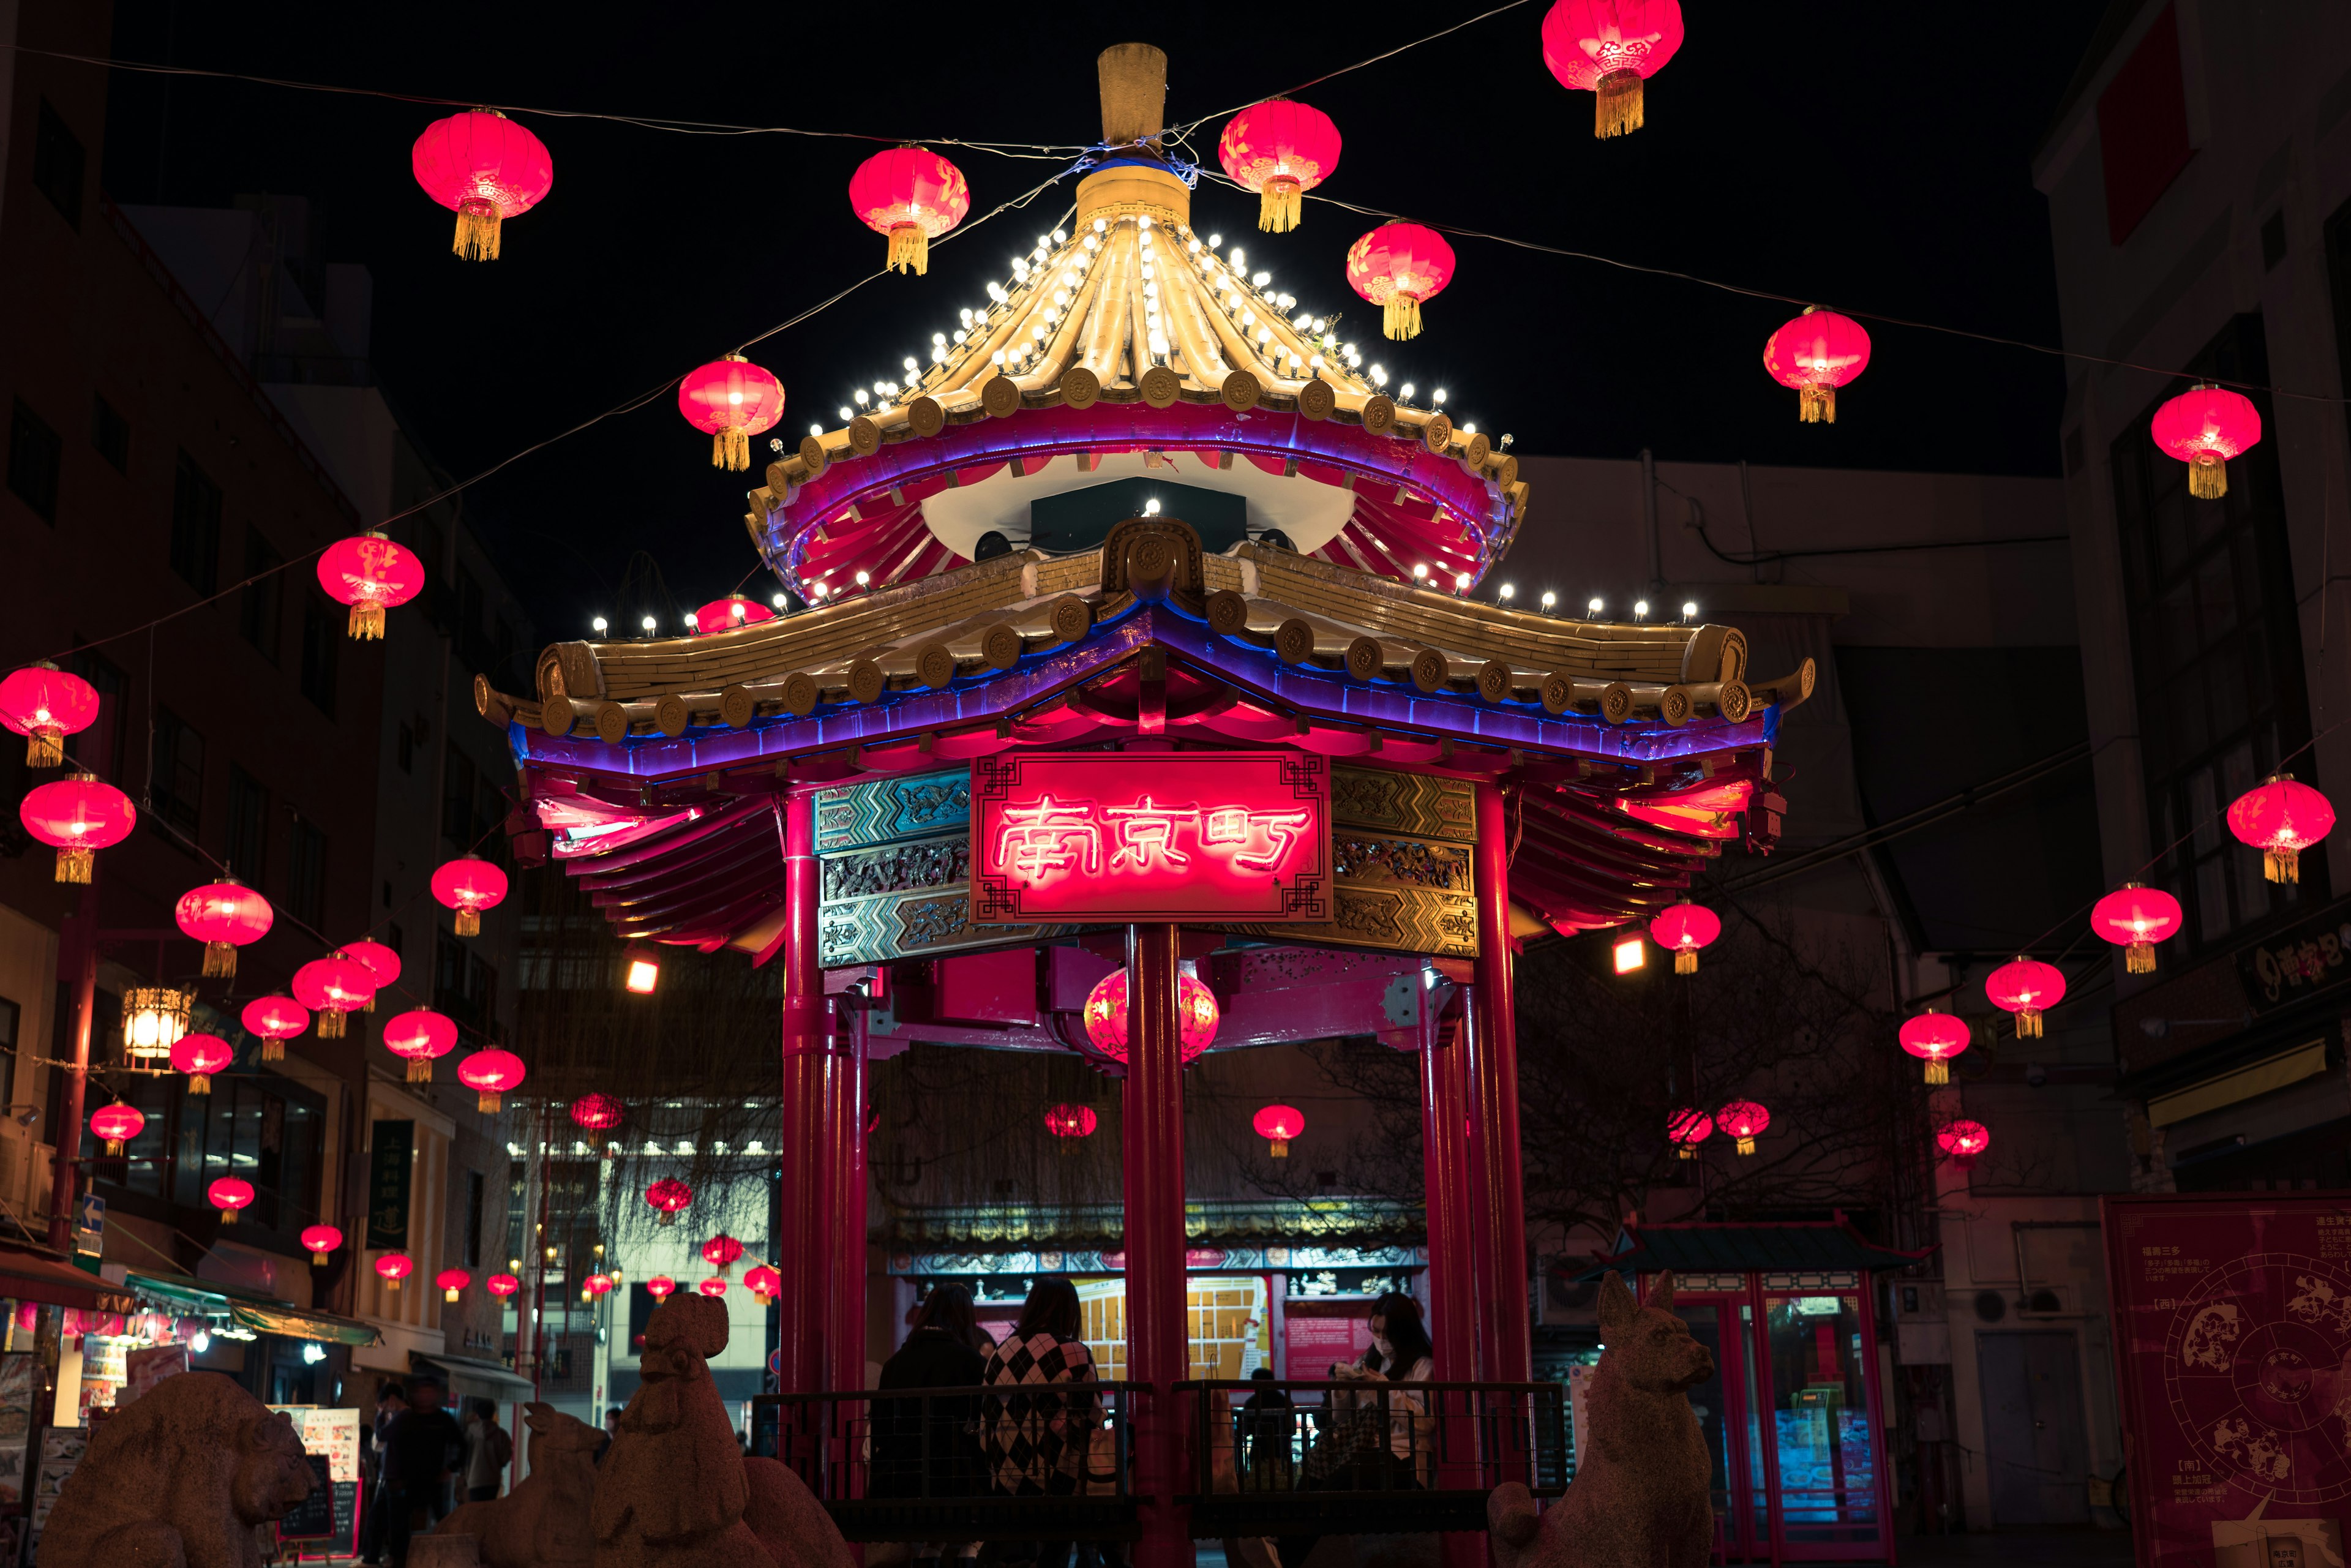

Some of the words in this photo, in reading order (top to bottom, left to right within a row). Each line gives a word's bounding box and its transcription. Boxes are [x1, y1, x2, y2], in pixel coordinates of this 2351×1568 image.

[996, 793, 1310, 879] 南京町
[2172, 1474, 2212, 1485] 頭上加冠
